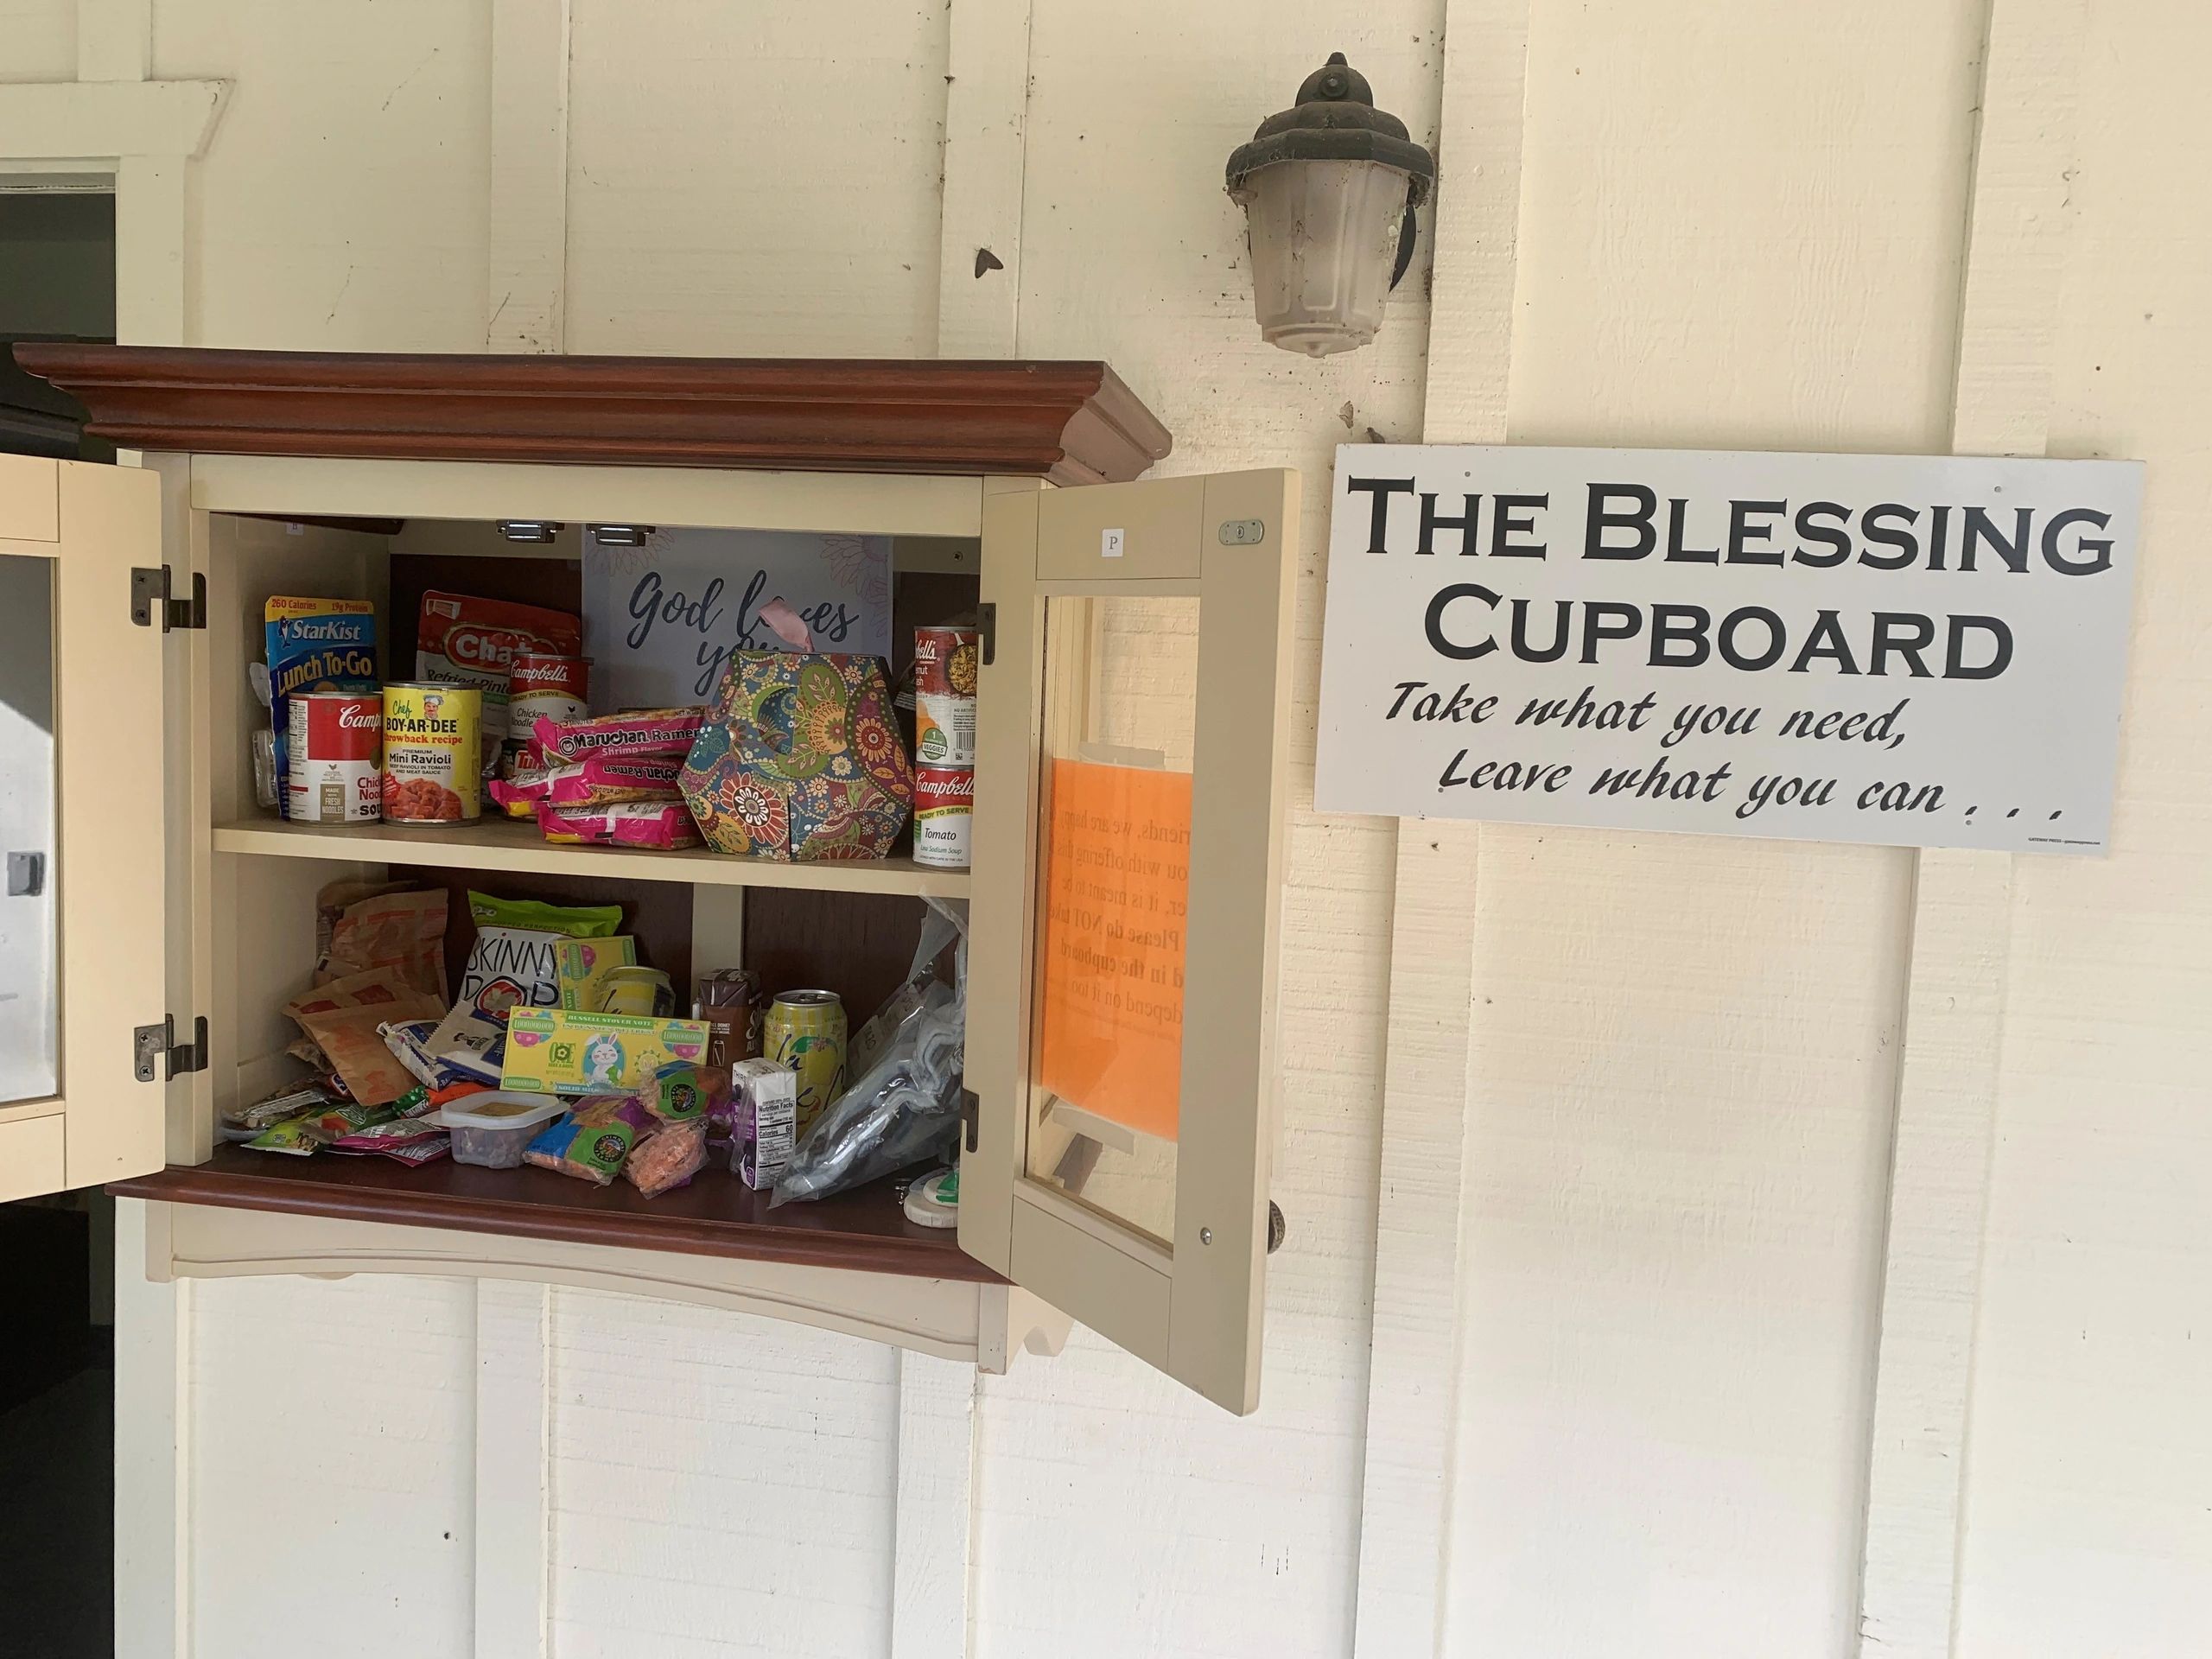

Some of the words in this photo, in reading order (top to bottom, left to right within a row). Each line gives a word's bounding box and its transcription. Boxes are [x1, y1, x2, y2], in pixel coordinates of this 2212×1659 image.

[1347, 475, 1549, 562] THE
[1580, 482, 2115, 576] BLESSING
[1109, 536, 1118, 550] P
[271, 599, 286, 608] 260
[289, 600, 317, 610] Calories
[332, 601, 343, 613] 19g
[345, 603, 368, 612] Protein
[626, 570, 724, 649] God
[737, 569, 860, 643] les
[292, 620, 361, 640] StarKist
[1424, 582, 2013, 680] CUPBOARD
[277, 654, 323, 698] Lunch
[322, 651, 372, 677] To-Go
[511, 659, 569, 683] Campbell's
[392, 700, 412, 719] Chef
[1385, 681, 1499, 724] Take
[1516, 685, 1656, 732] what
[1660, 704, 1762, 748] you
[1779, 698, 1910, 750] need,
[338, 704, 381, 732] Camp
[386, 718, 457, 733] BOY-AR-DEE
[432, 734, 463, 746] recipe
[573, 729, 647, 748] Maruchan
[602, 746, 639, 756] Shrimp
[924, 743, 945, 753] VEGGIES
[389, 753, 409, 764] Mini
[411, 754, 451, 765] Ravioli
[604, 765, 644, 779] Ramen
[1439, 748, 1573, 793] Leave
[1588, 755, 1732, 803] what
[1736, 775, 1838, 819] you
[1858, 781, 1946, 813] can
[918, 810, 934, 819] READY
[925, 827, 957, 841] Tomato
[929, 845, 948, 854] Sodium
[759, 1103, 779, 1113] Nutrition
[780, 1101, 794, 1110] Facts
[759, 1128, 779, 1138] Calories
[785, 1124, 793, 1134] 60
